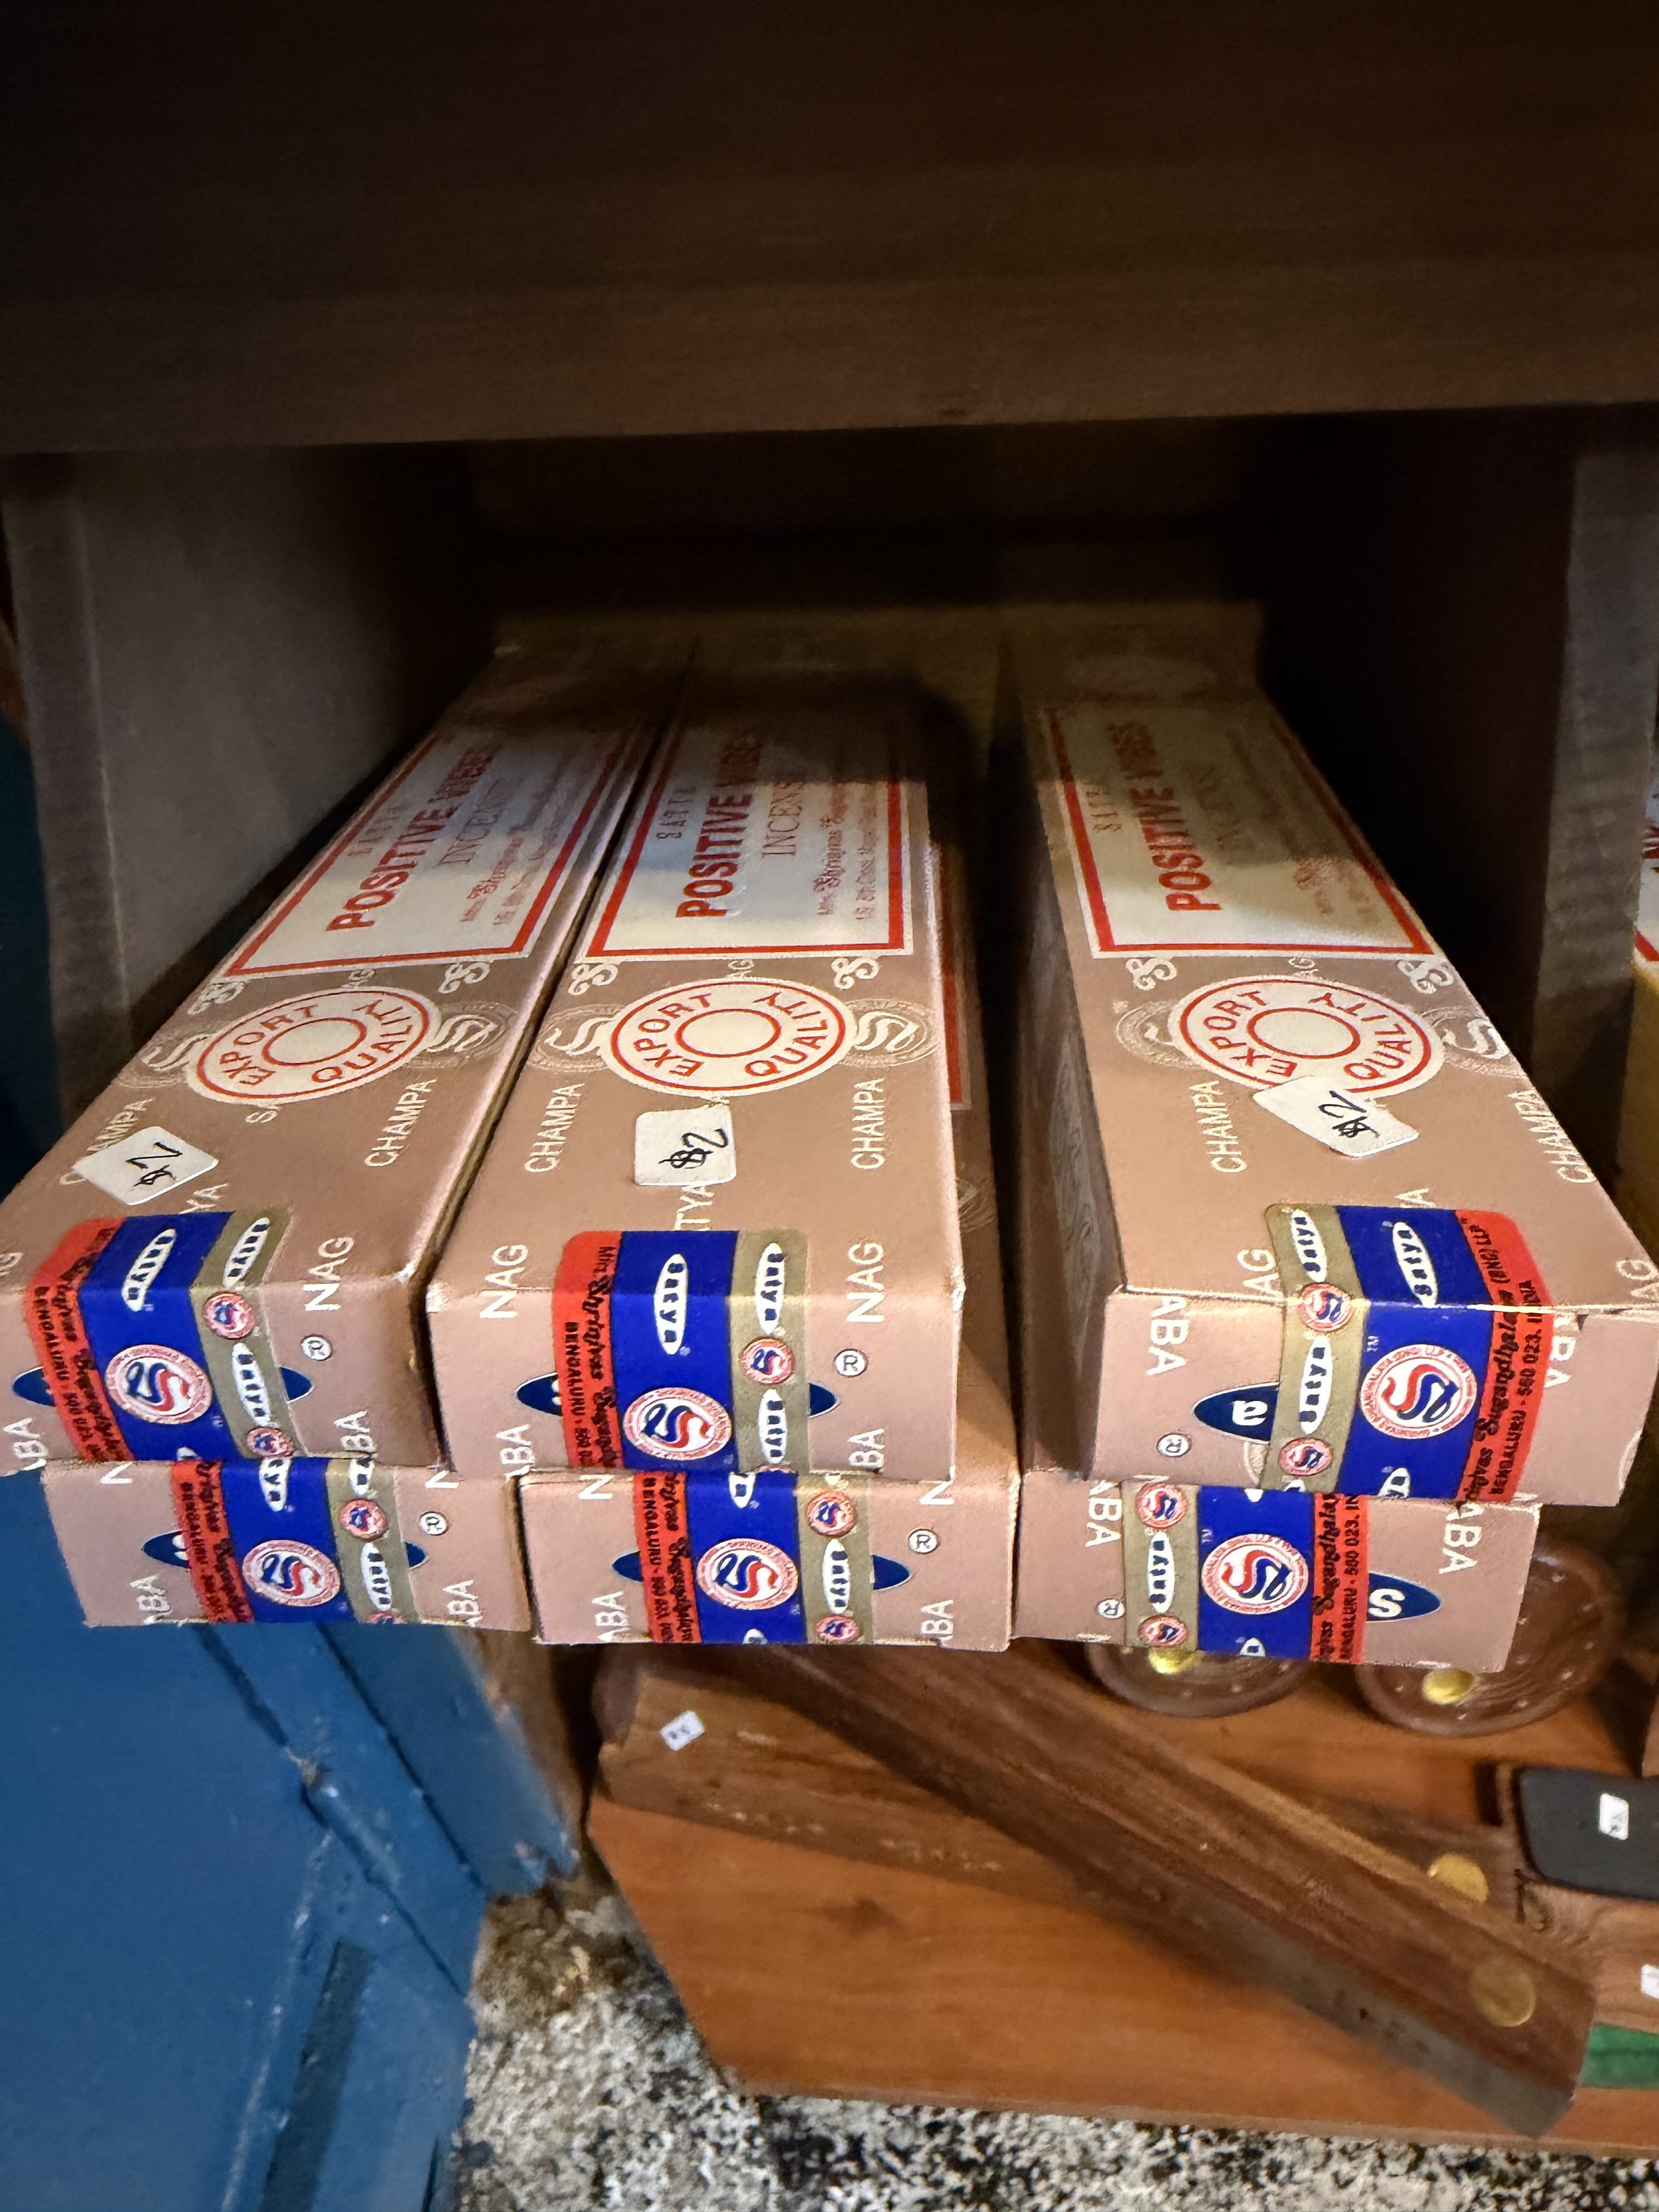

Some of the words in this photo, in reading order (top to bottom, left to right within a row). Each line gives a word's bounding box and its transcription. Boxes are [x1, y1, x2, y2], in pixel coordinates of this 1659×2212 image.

[676, 793, 753, 919] POSITIVE
[762, 780, 806, 859] INCENS
[1128, 787, 1222, 911] POSITIVE
[326, 804, 461, 931] POSITIVE
[220, 1005, 319, 1086] EXPORT
[311, 999, 413, 1083] QUALITY
[635, 992, 714, 1078] EXPORT
[745, 991, 830, 1078] QUALITY
[1202, 990, 1299, 1078] EXPORT
[1307, 992, 1413, 1080] QUALITY
[658, 1128, 729, 1170] $2
[850, 1076, 887, 1171] CHAMPA
[1190, 1080, 1248, 1173] CHAMPA
[1318, 1090, 1382, 1140] $2
[1506, 1089, 1597, 1185] CHAMPA
[303, 1236, 355, 1312] NAG
[364, 1077, 438, 1168] CHAMPA
[480, 1243, 529, 1320] NAG
[524, 1082, 586, 1173] CHAMPA
[846, 1241, 885, 1324] NAG
[1238, 1247, 1282, 1296] AG
[565, 1321, 585, 1416] BENGALURU
[1488, 1410, 1526, 1495] BENGALURU
[642, 1477, 662, 1566] BENGALURU
